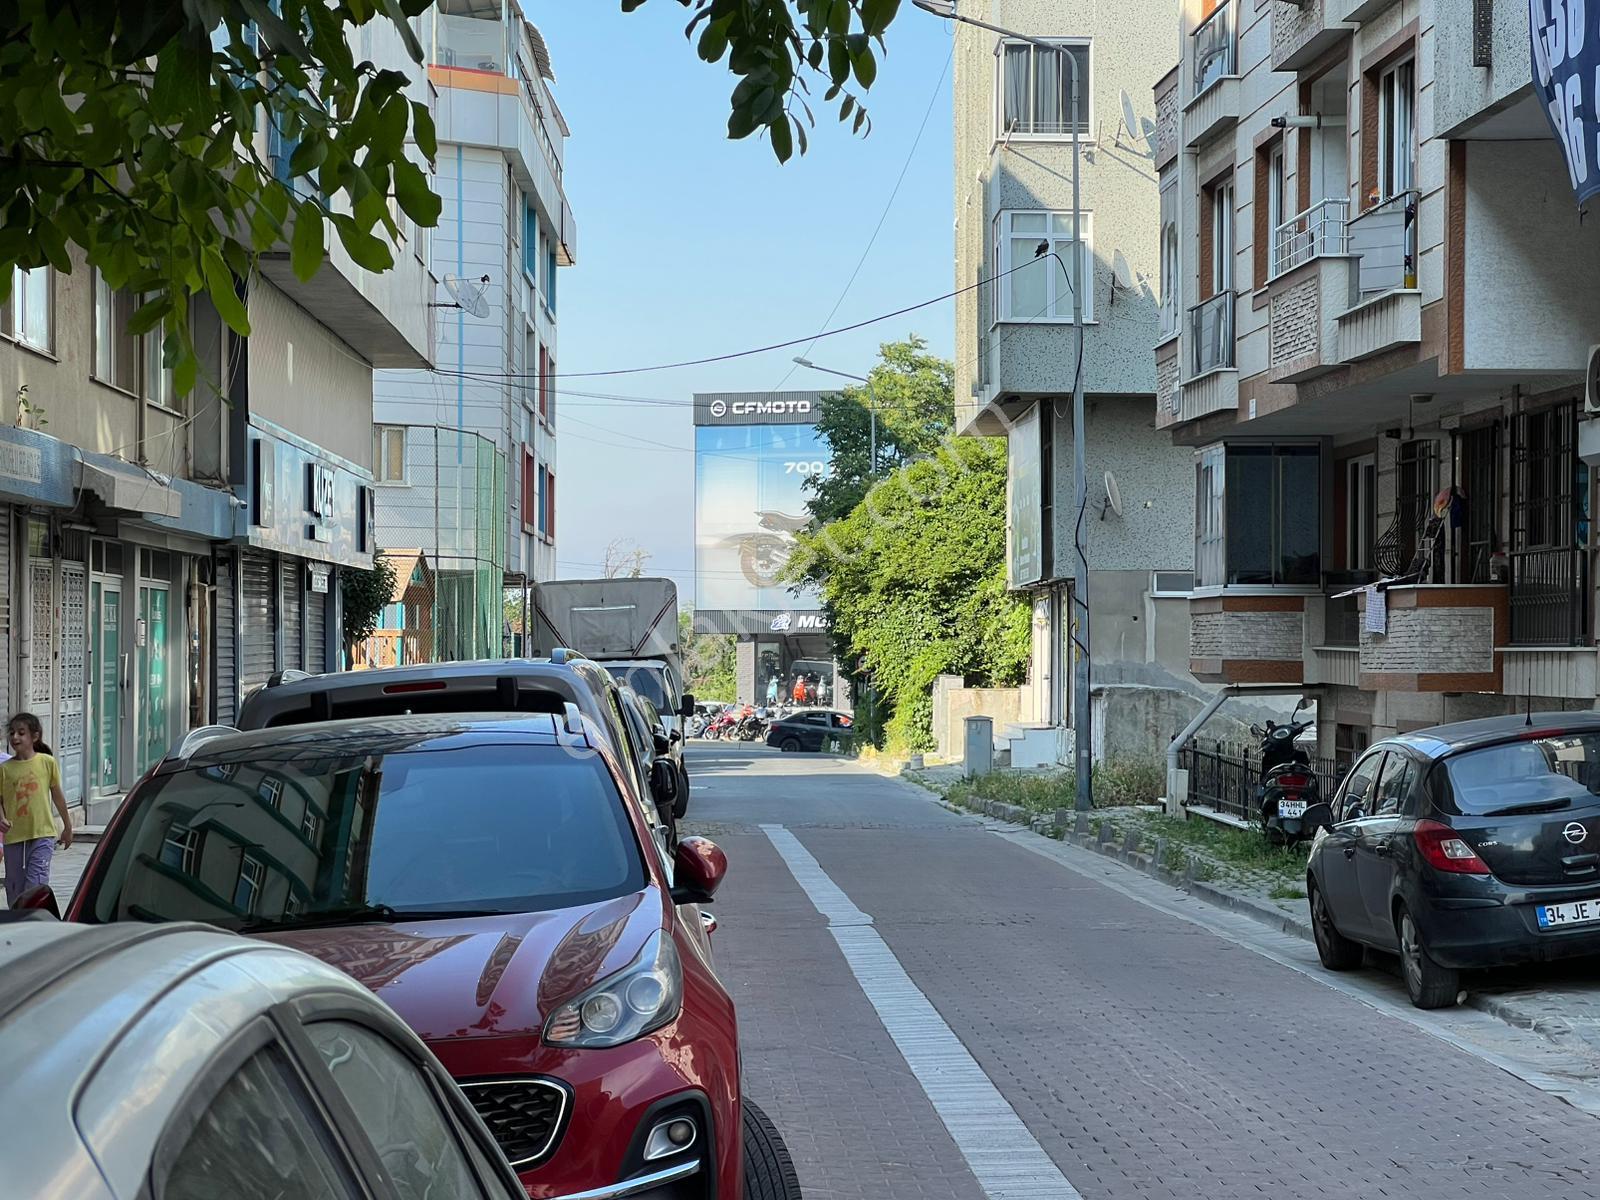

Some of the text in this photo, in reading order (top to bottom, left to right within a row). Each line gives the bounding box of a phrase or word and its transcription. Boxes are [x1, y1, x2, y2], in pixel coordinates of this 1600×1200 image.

[732, 400, 811, 414] CFMOTO
[784, 461, 824, 474] 700
[1546, 906, 1565, 923] 34
[1572, 903, 1590, 919] JE
